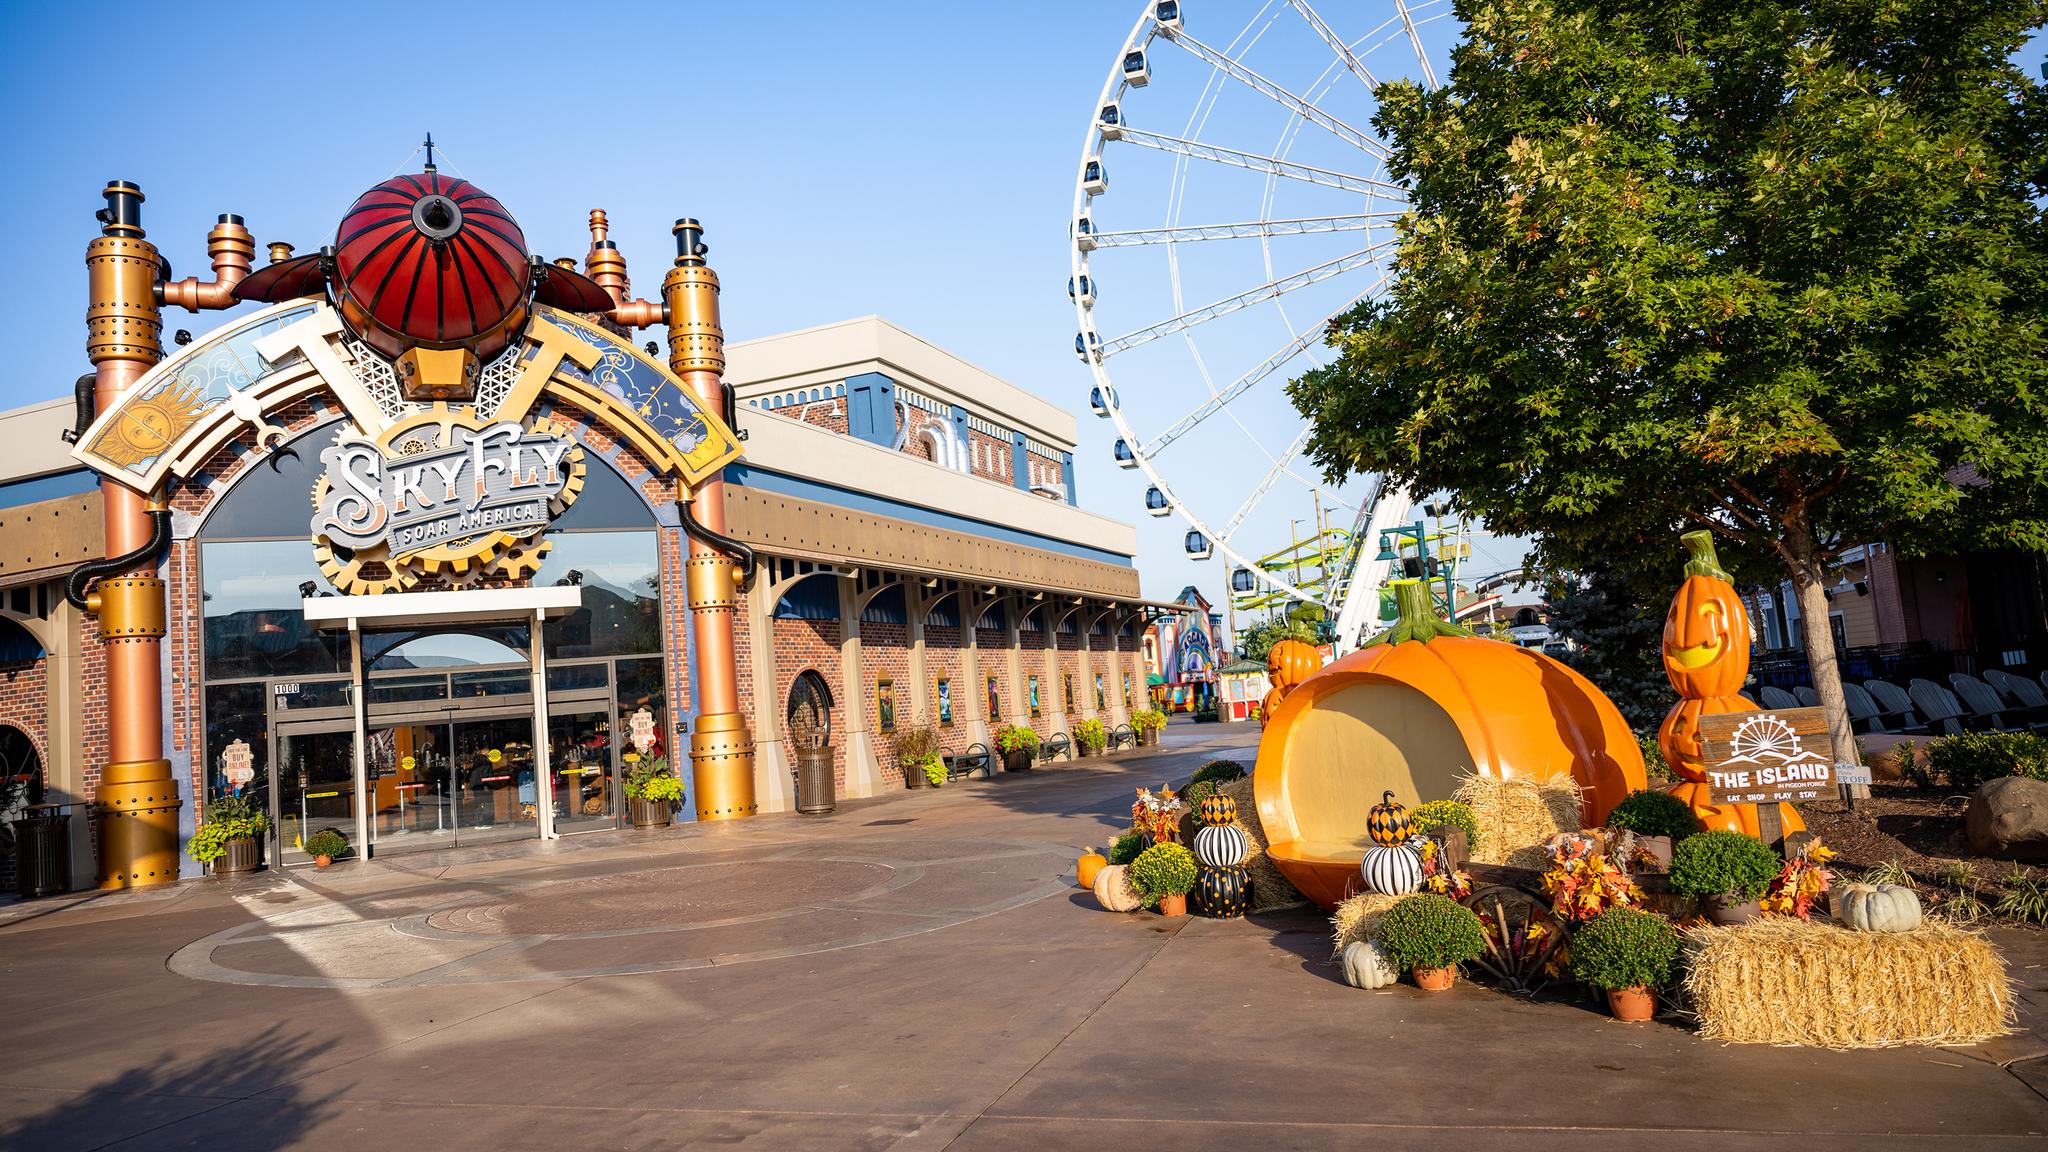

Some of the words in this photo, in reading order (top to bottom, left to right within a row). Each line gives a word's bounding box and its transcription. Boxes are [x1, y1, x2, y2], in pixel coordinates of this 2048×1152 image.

[404, 521, 449, 543] SOAR
[459, 504, 533, 531] AMERICA
[1184, 631, 1210, 655] ARCADE
[276, 683, 298, 693] 1000
[232, 753, 244, 761] BUY
[228, 761, 249, 769] ONLINE!
[1709, 771, 1750, 788] THE
[1755, 764, 1829, 785] ISLAND
[1747, 793, 1766, 801] SHOP
[1774, 792, 1792, 800] PLAY
[1799, 791, 1817, 799] STAY
